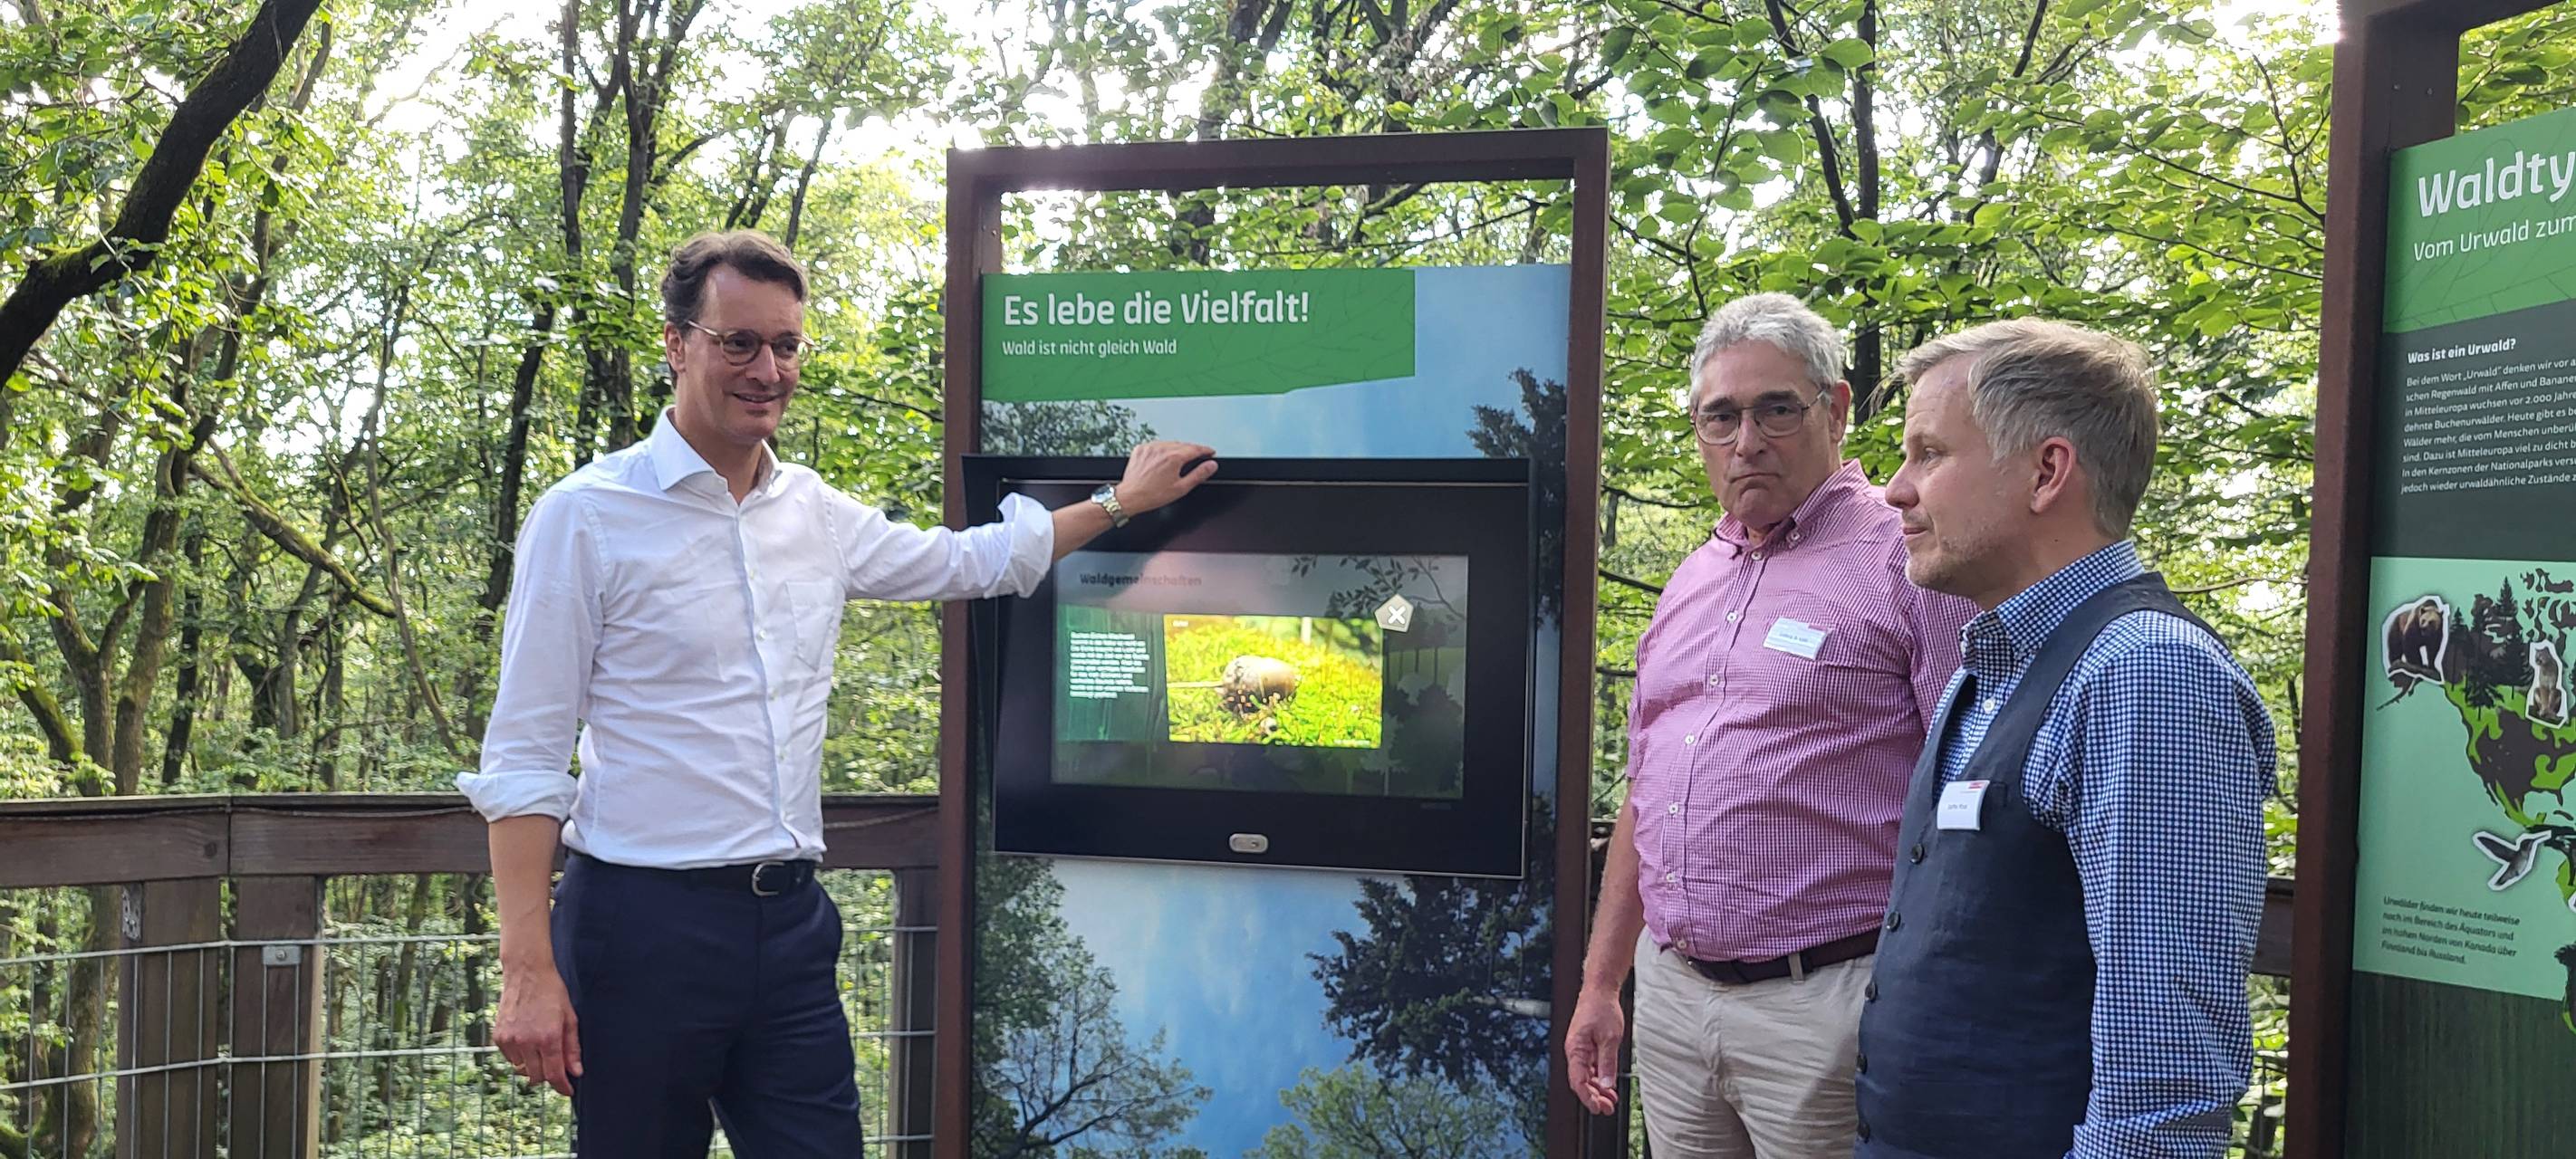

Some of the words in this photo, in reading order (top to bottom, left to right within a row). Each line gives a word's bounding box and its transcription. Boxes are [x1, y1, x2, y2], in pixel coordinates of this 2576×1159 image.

[2418, 150, 2576, 217] Waldty
[2414, 239, 2454, 262] Vom
[2459, 219, 2529, 253] Urwald
[2536, 216, 2576, 237] zum
[1004, 295, 1039, 325] Es
[1048, 292, 1115, 325] lebe
[1123, 290, 1171, 324] die
[1180, 289, 1309, 324] Vielfalt!
[1002, 340, 1035, 355] Wald
[1039, 340, 1056, 354] ist
[1060, 340, 1094, 355] nicht
[1098, 340, 1139, 359] gleich
[1142, 339, 1177, 354] Wald
[2408, 351, 2430, 364] Was
[2432, 348, 2446, 360] ist
[2447, 345, 2465, 359] ein
[2467, 338, 2516, 356] Urwald?
[2407, 377, 2419, 387] Bei
[2420, 375, 2439, 385] dem
[2441, 372, 2462, 382] Wort
[2503, 363, 2535, 375] denken
[2537, 359, 2552, 370] wir
[2553, 359, 2569, 368] vor
[2406, 392, 2429, 402] schen
[2431, 384, 2477, 400] Regenwald
[2478, 384, 2494, 392] mit
[2494, 380, 2518, 391] Affen
[2520, 378, 2537, 388] und
[2405, 407, 2413, 417] in
[2414, 403, 2467, 416] Mitteleuropa
[2469, 398, 2507, 410] wuchsen
[2509, 398, 2523, 406] vor
[2524, 394, 2552, 404] 2.000
[2404, 422, 2433, 432] dehnte
[2507, 412, 2535, 422] Heute
[2536, 409, 2554, 422] gibt
[2403, 436, 2432, 447] Wälder
[2434, 434, 2457, 445] mehr,
[2458, 433, 2472, 442] die
[2473, 432, 2492, 441] vom
[2494, 427, 2539, 439] Menschen
[2423, 451, 2444, 461] Dazu
[2445, 449, 2456, 459] ist
[2457, 446, 2513, 457] Mitteleuropa
[2514, 442, 2531, 453] viel
[2533, 444, 2543, 452] zu
[2544, 440, 2569, 451] dicht
[2401, 468, 2410, 477] In
[2411, 467, 2427, 476] den
[2428, 465, 2473, 475] Kernzonen
[2474, 463, 2489, 472] der
[2491, 457, 2553, 471] Nationalparks
[2400, 482, 2428, 494] jedoch
[2429, 480, 2458, 491] wieder
[2459, 475, 2526, 489] urwaldähnliche
[2527, 473, 2571, 484] Zustände
[1080, 572, 1202, 588] Waldgemeinschaften
[2459, 908, 2482, 919] heute
[2414, 915, 2443, 927] Bereich
[2497, 931, 2514, 941] und
[2419, 932, 2447, 944] Norden
[2465, 940, 2495, 953] Kanada
[2497, 945, 2517, 957] über
